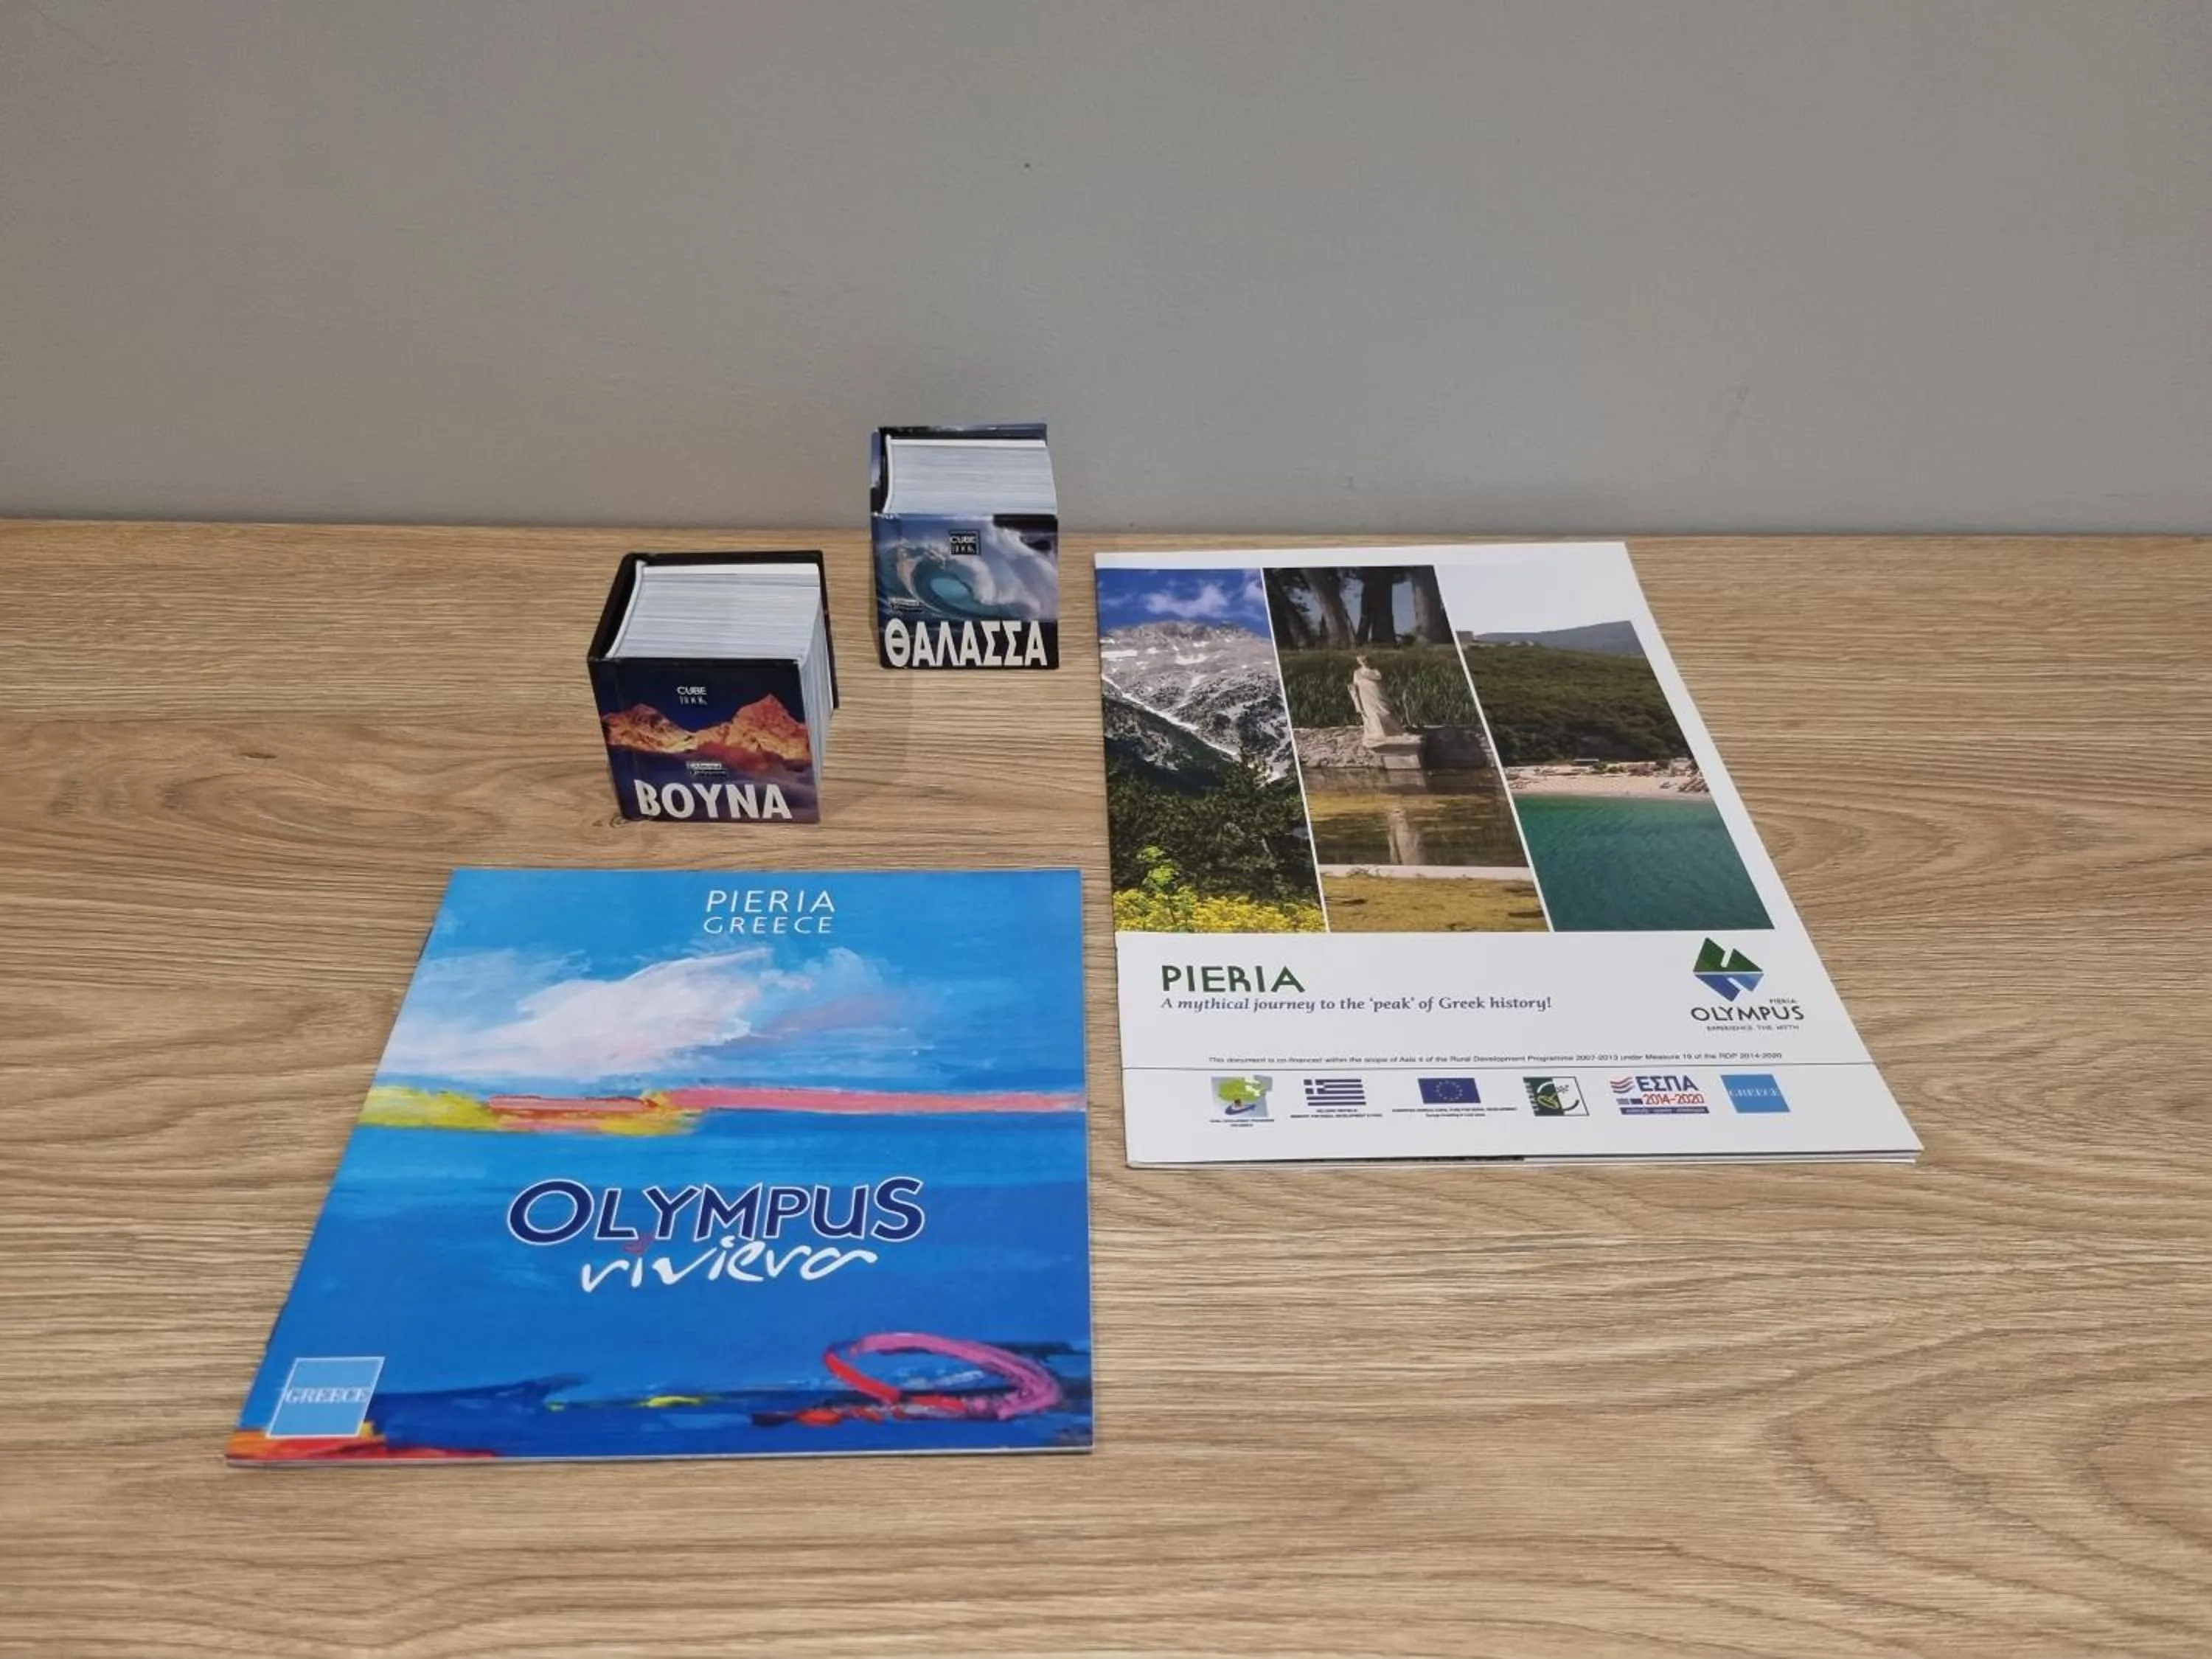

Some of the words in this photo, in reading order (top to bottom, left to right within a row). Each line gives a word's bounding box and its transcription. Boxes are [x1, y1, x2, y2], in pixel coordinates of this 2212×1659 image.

[885, 618, 1048, 667] ΘΑΛΑΣΣΑ
[676, 686, 707, 695] CUBE
[706, 889, 835, 913] PIERIA
[703, 917, 833, 933] GREECE
[1161, 964, 1306, 993] PIERIA
[1161, 998, 1172, 1009] A
[1178, 998, 1251, 1013] mythical
[1253, 999, 1315, 1013] journey
[1320, 999, 1335, 1009] to
[1340, 998, 1365, 1009] the
[1418, 996, 1435, 1012] of
[1438, 997, 1485, 1009] Greek
[1489, 996, 1552, 1012] history!
[1690, 1005, 1805, 1022] OLYMPUS
[1473, 1055, 1525, 1063] Development
[1739, 1051, 1782, 1060] 2014-2020
[1635, 1075, 1699, 1093] ΕΣΠΑ
[1643, 1093, 1705, 1105] 2014-2020
[507, 1176, 925, 1245] OLYMPUS
[581, 1234, 878, 1293] riviera
[284, 1387, 369, 1403] GREECE
